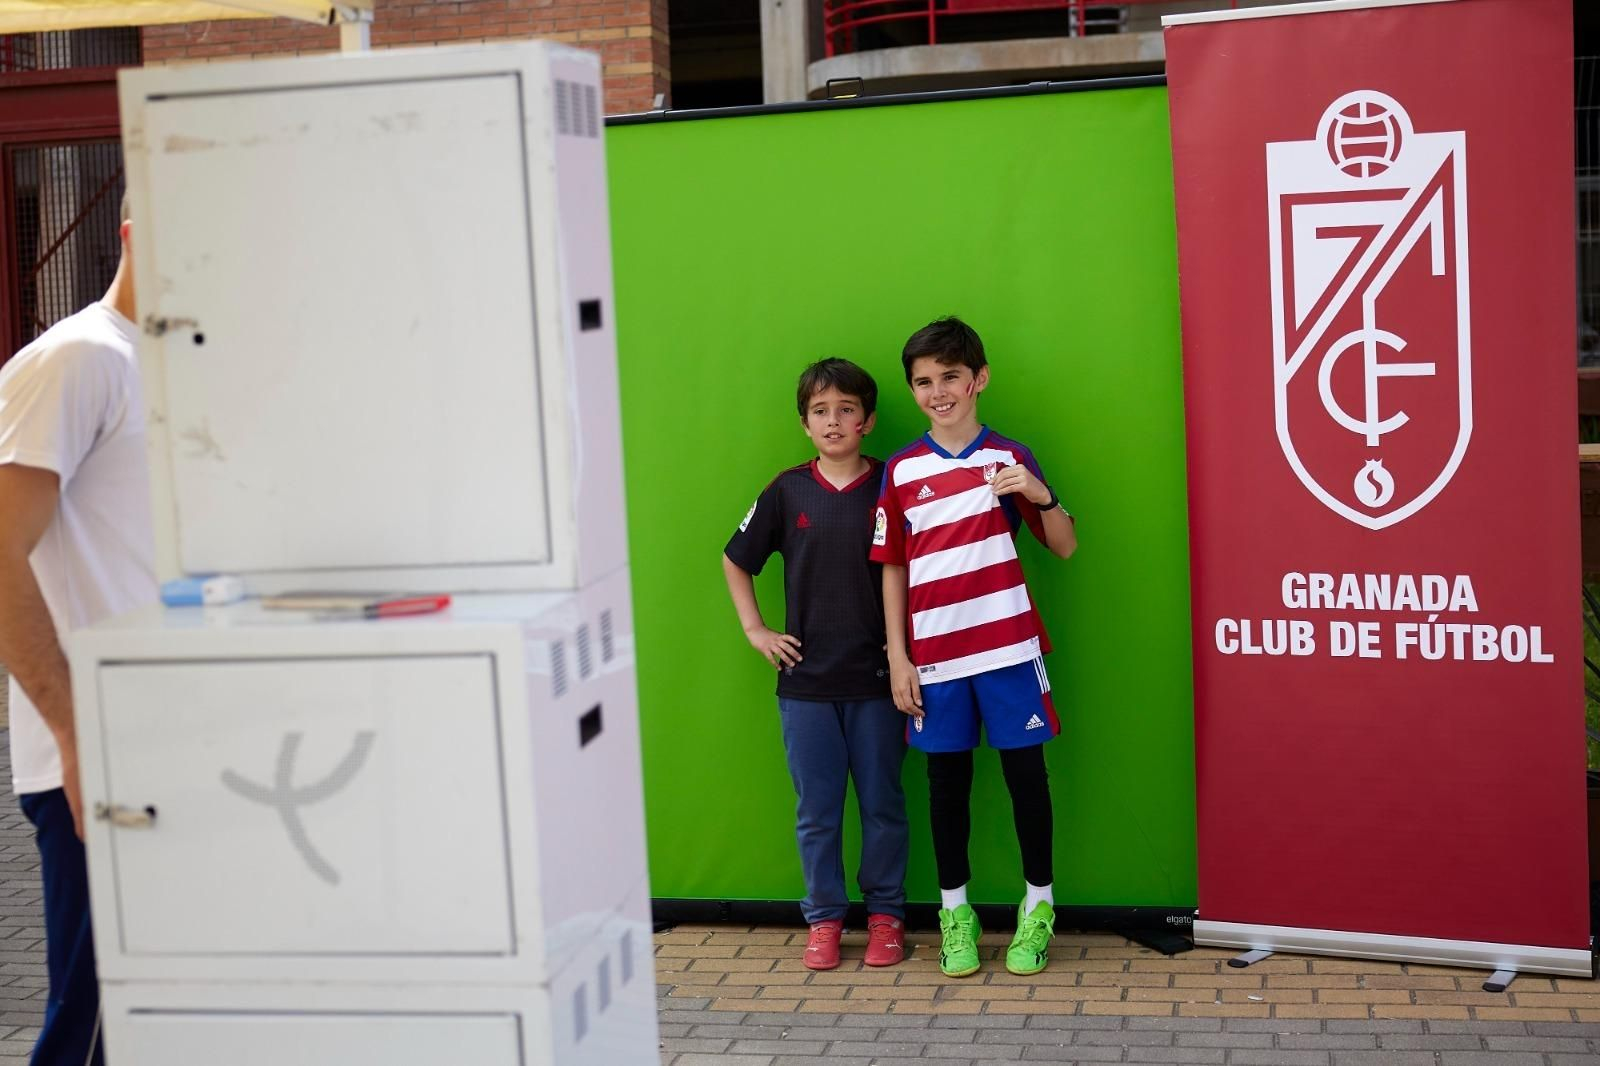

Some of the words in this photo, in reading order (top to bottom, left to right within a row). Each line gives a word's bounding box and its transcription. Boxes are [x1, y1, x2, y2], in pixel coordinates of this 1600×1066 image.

[1281, 572, 1479, 612] GRANADA
[1215, 618, 1316, 656] CLUB
[1329, 621, 1382, 659] DE
[1395, 614, 1554, 663] FÚTBOL
[1166, 915, 1192, 926] elgato
